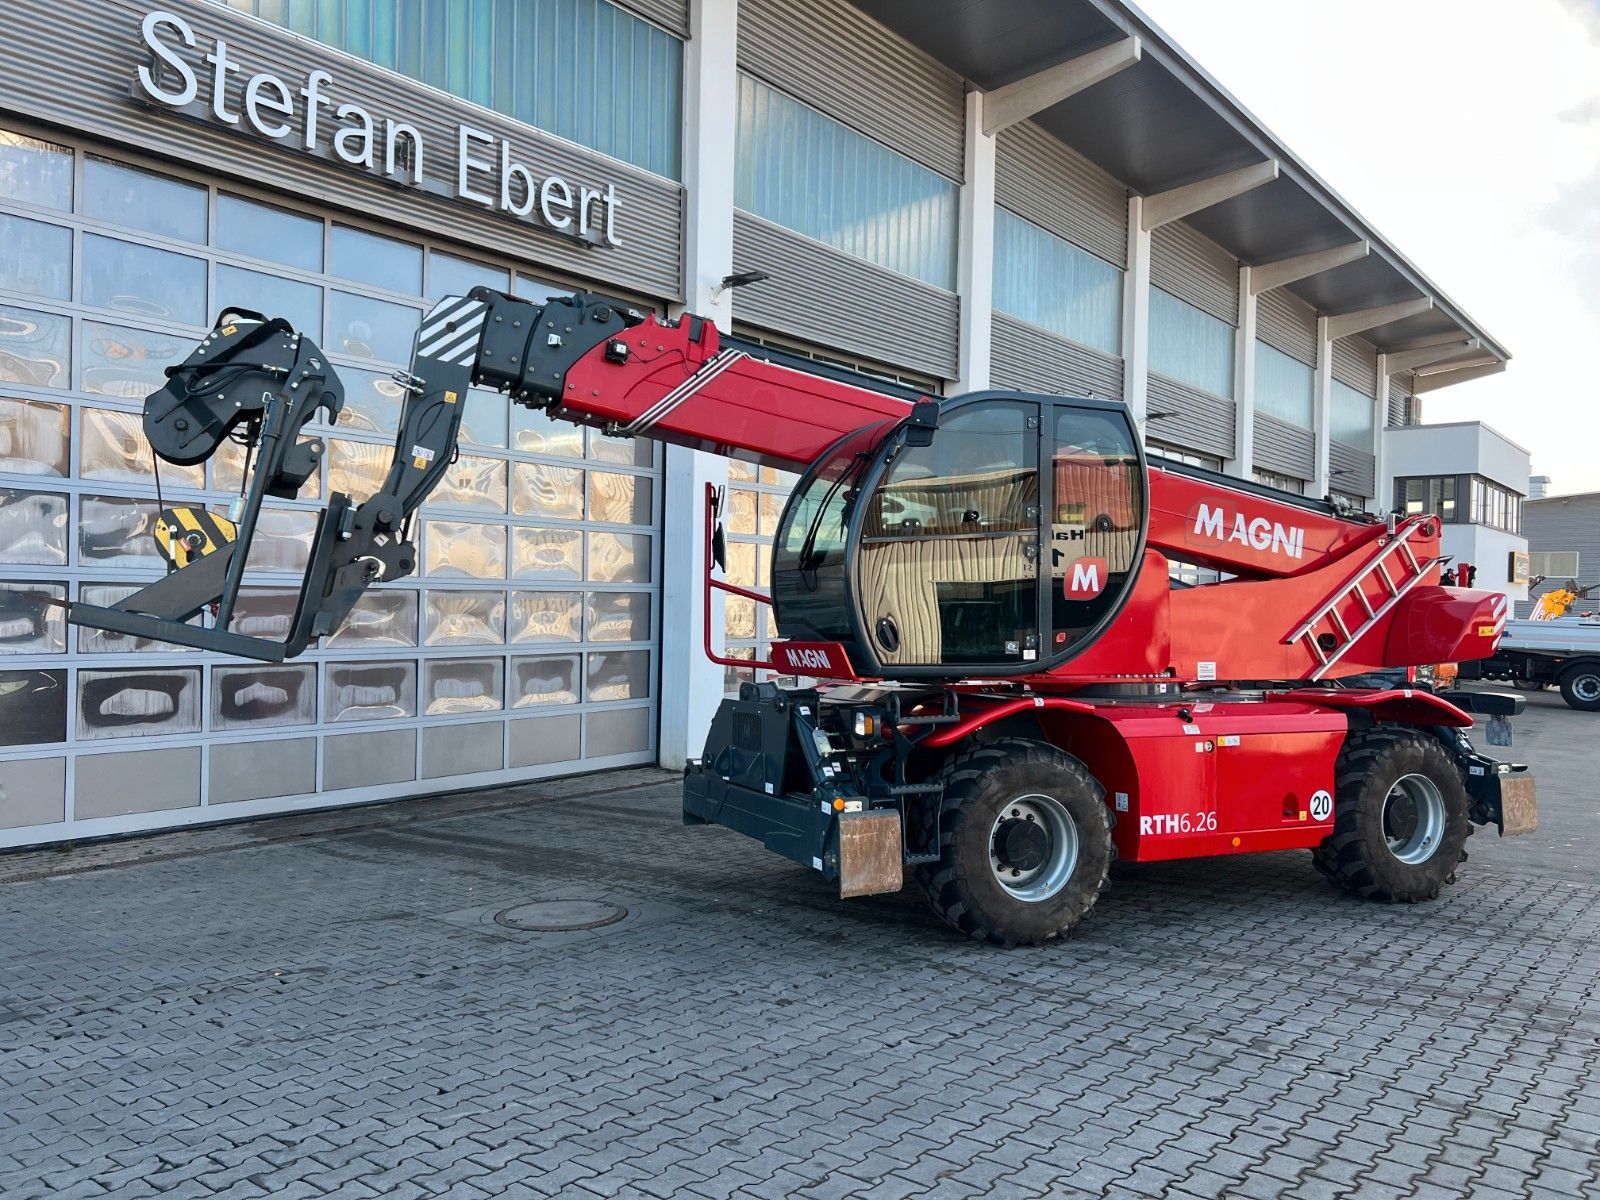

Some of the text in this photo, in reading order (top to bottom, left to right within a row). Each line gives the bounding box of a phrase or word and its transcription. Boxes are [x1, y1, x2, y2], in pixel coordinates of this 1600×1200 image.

[135, 11, 624, 247] Stefan Ebert
[1193, 503, 1305, 560] MAGNI
[1071, 563, 1099, 592] M
[785, 648, 832, 669] MAGNI
[1313, 795, 1330, 816] 20
[1140, 811, 1218, 836] RTH6.26
